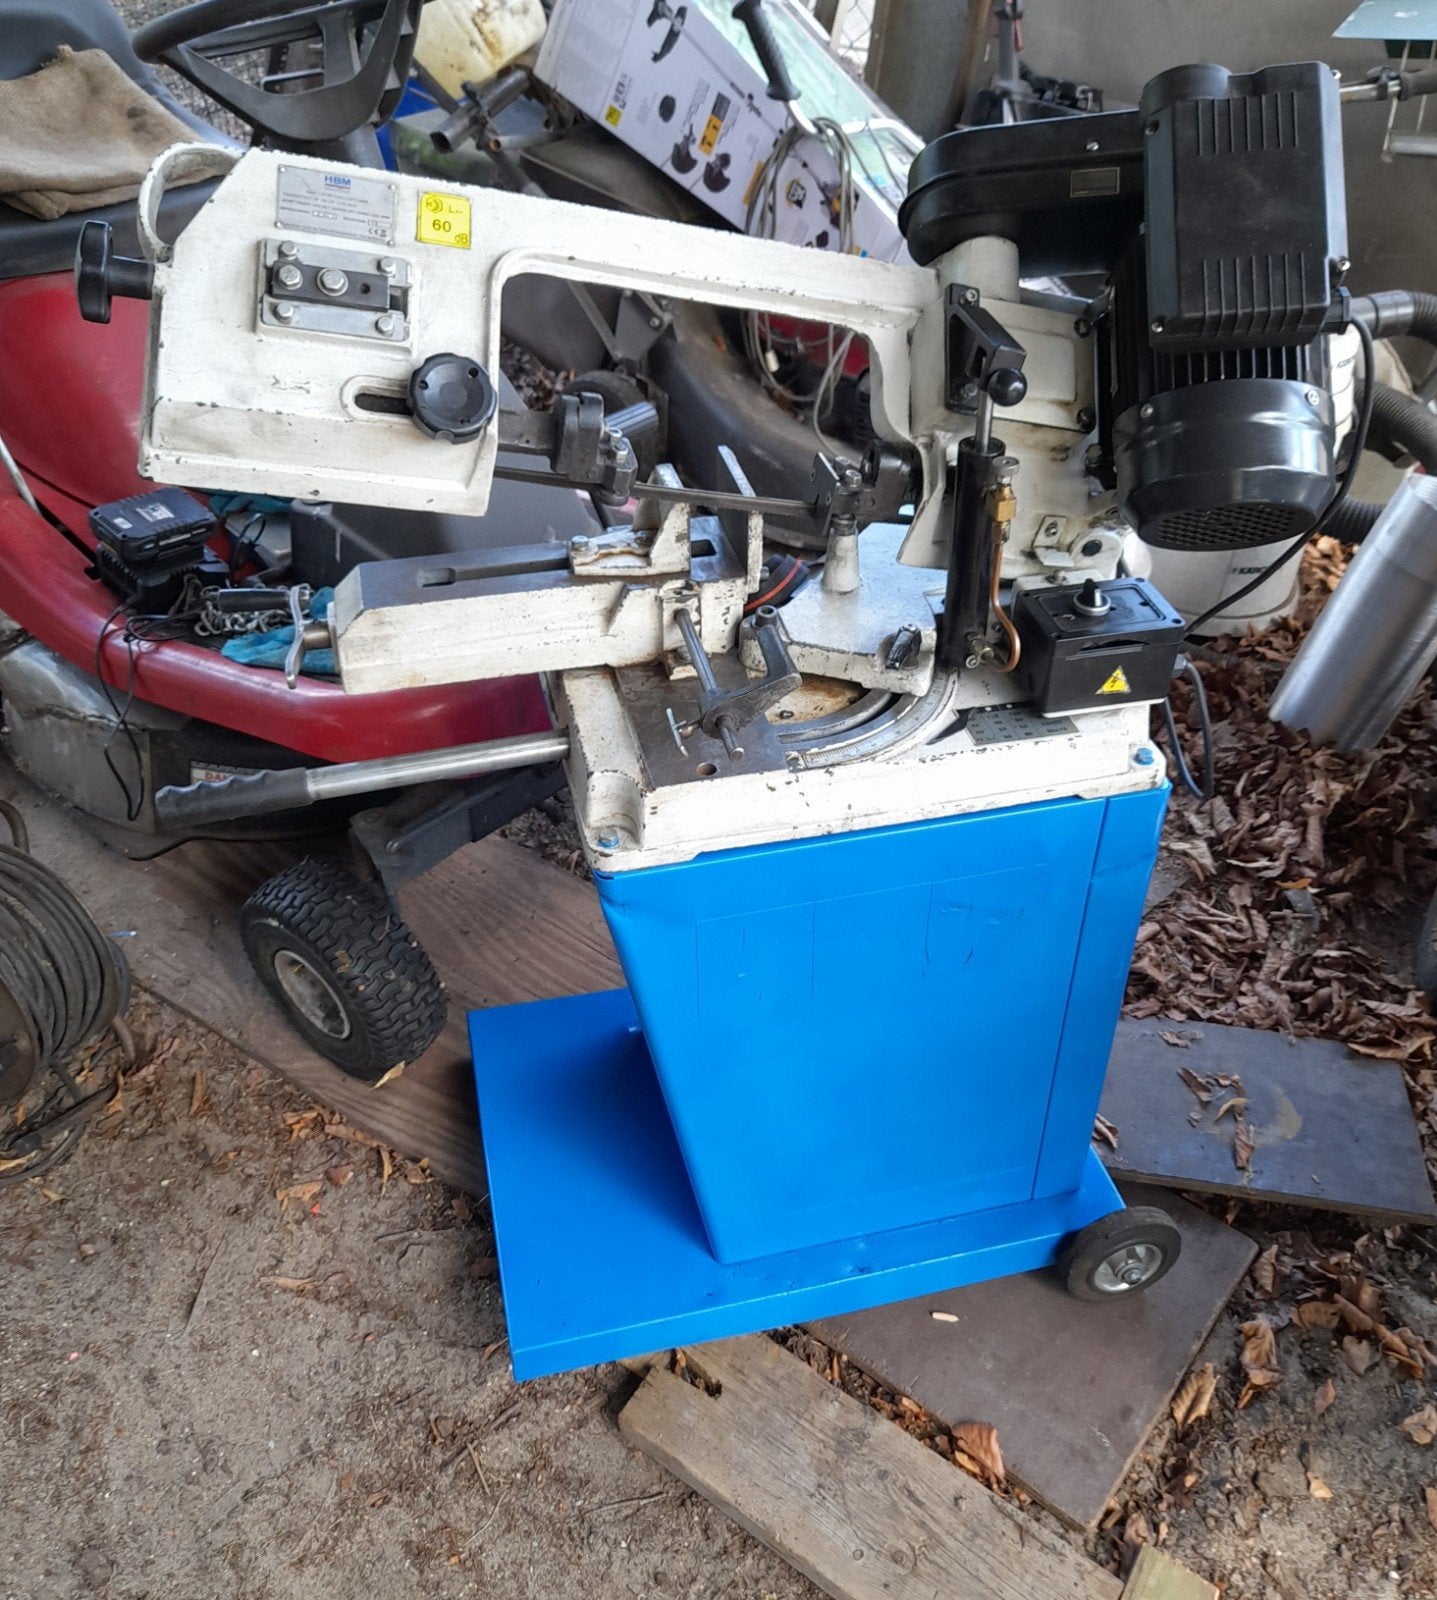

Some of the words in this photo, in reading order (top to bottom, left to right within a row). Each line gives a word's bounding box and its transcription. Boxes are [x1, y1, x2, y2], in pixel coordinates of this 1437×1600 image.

[324, 174, 351, 186] HBM
[432, 218, 452, 233] 60
[454, 232, 469, 245] dB
